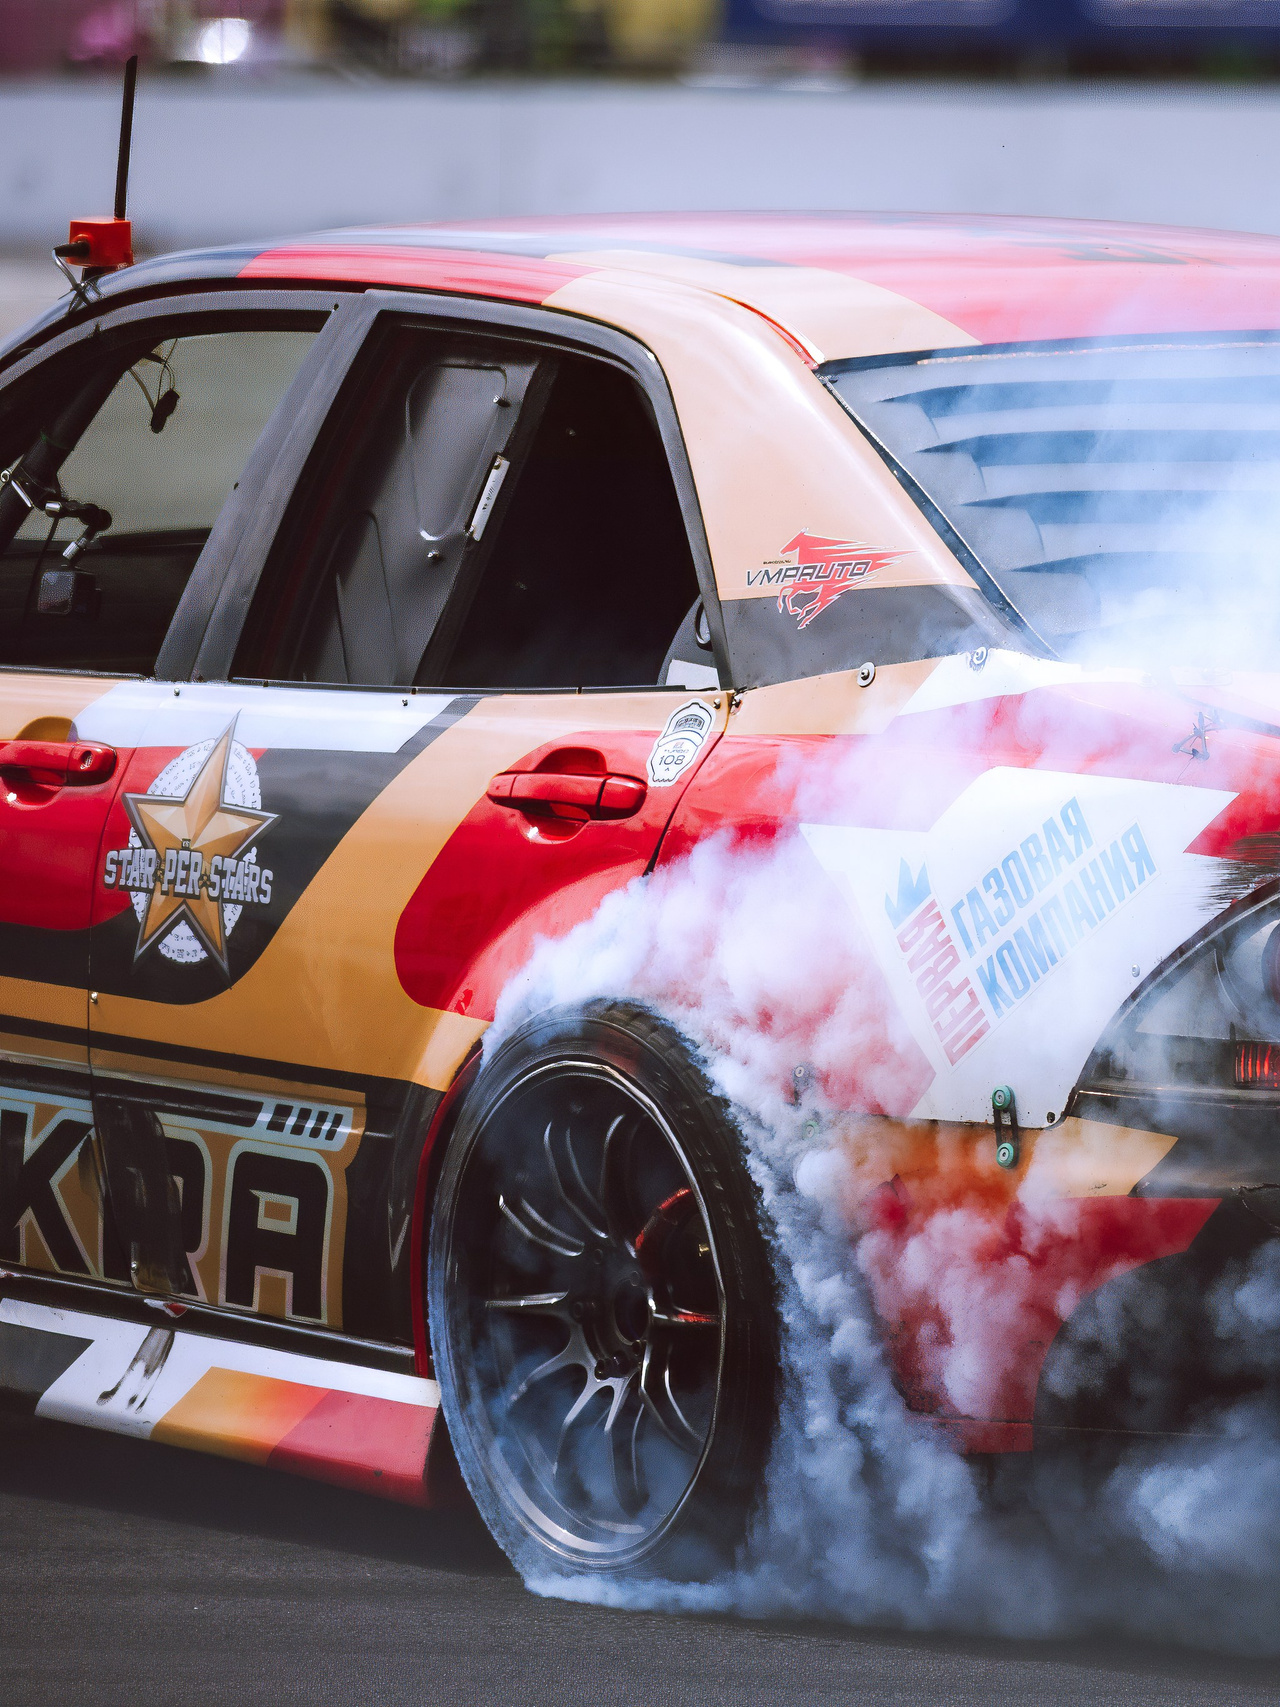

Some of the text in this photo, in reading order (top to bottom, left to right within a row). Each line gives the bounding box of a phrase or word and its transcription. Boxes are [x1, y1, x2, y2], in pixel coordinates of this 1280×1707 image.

[746, 560, 873, 587] VMPAUTO
[658, 754, 686, 766] 108
[104, 849, 274, 904] STAR PER STARS
[950, 795, 1095, 959] ГАЗОВАЯ
[975, 822, 1158, 1019] КОМПАНИЯ
[896, 898, 992, 1067] ПЕРВАЯ
